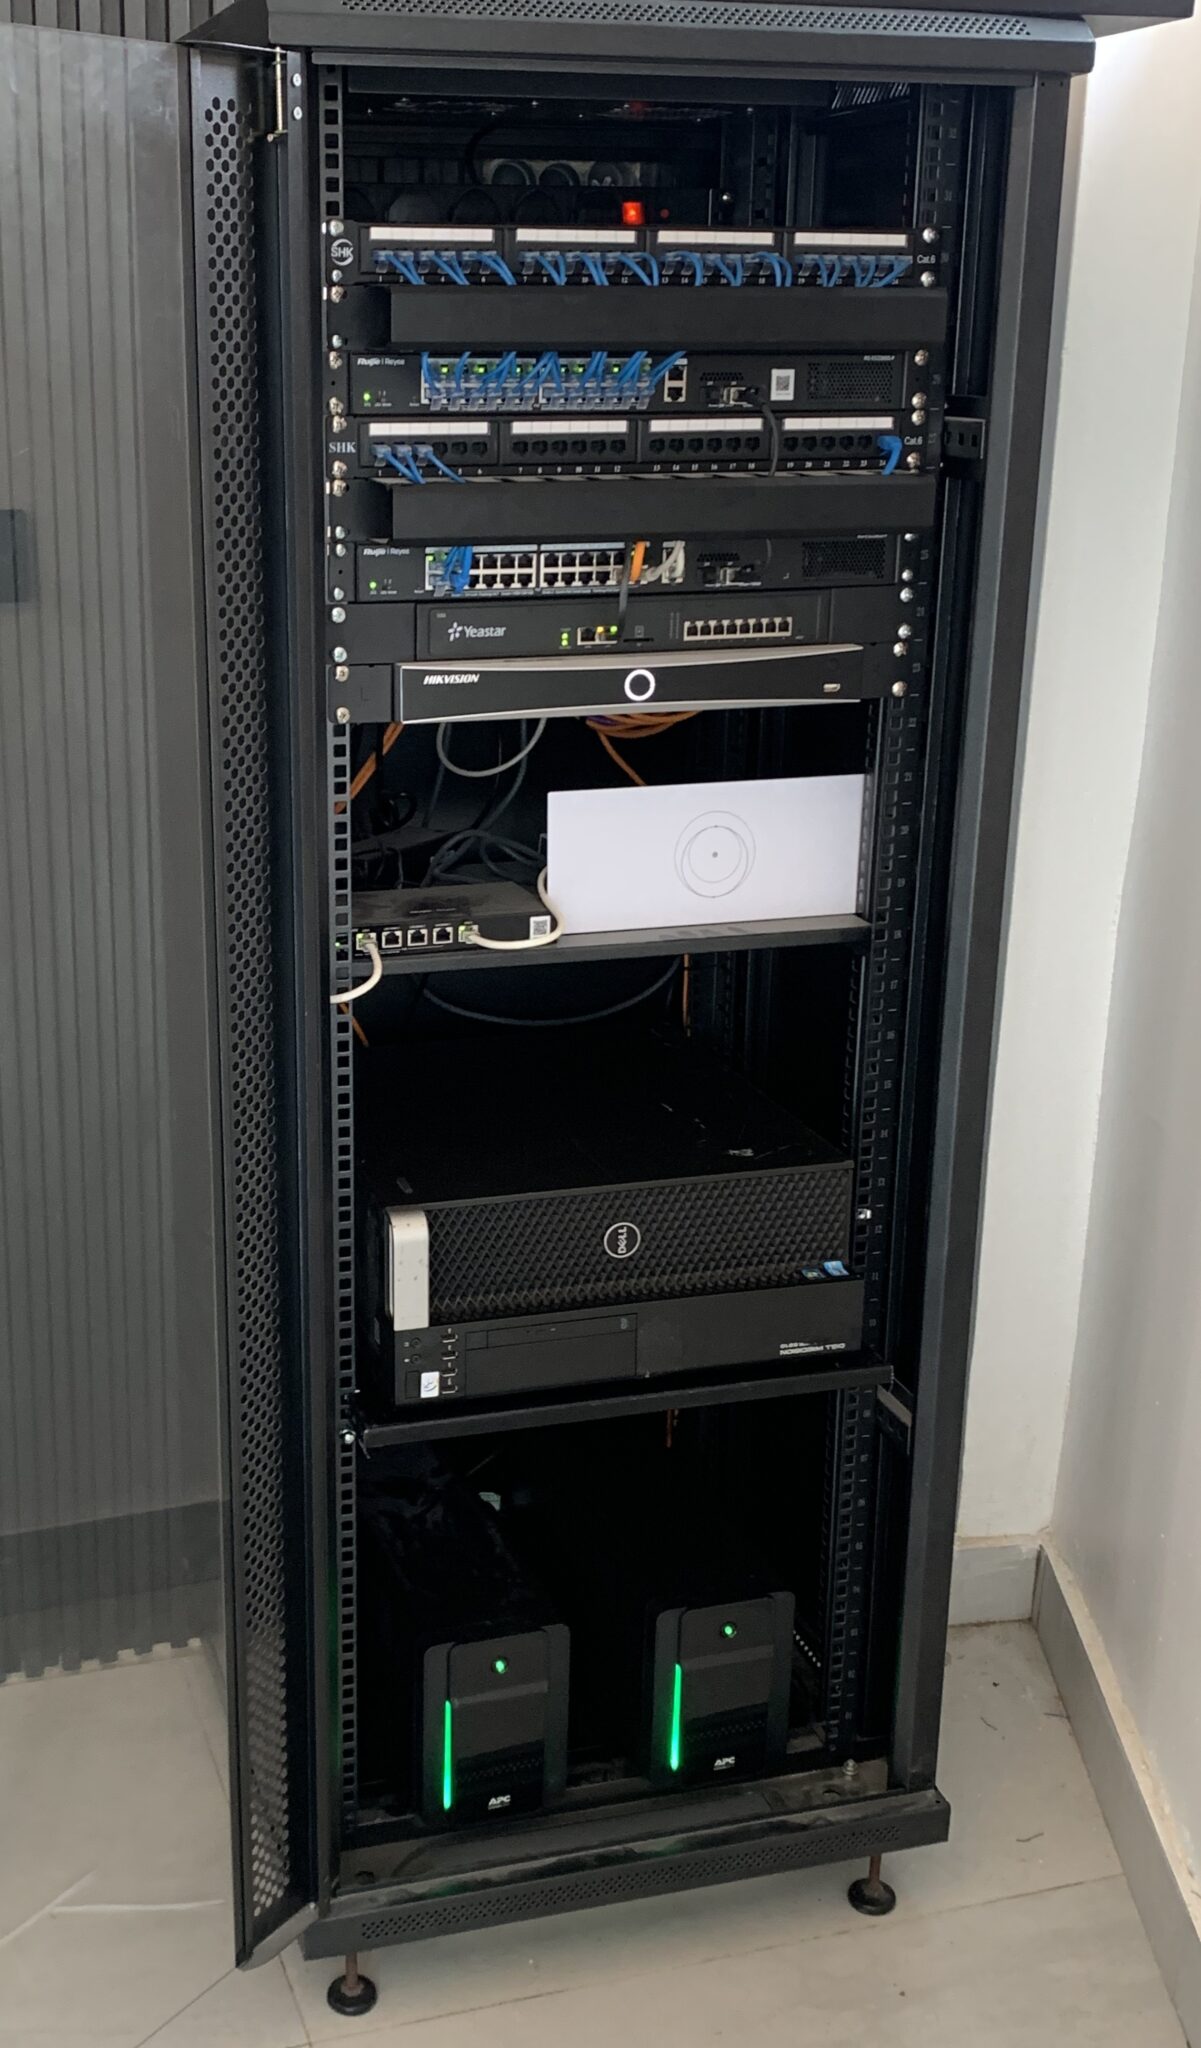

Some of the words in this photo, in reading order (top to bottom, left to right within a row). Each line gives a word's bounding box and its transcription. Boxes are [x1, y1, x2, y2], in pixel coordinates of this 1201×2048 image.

[331, 247, 354, 258] SHK
[916, 255, 936, 264] Cat.6
[904, 436, 923, 445] Cat.6
[329, 441, 356, 453] SHK
[463, 626, 507, 638] Yeastar
[423, 673, 480, 685] HIKVISION
[617, 1226, 627, 1254] DELL
[714, 1756, 735, 1766] APC
[488, 1795, 511, 1805] APC
